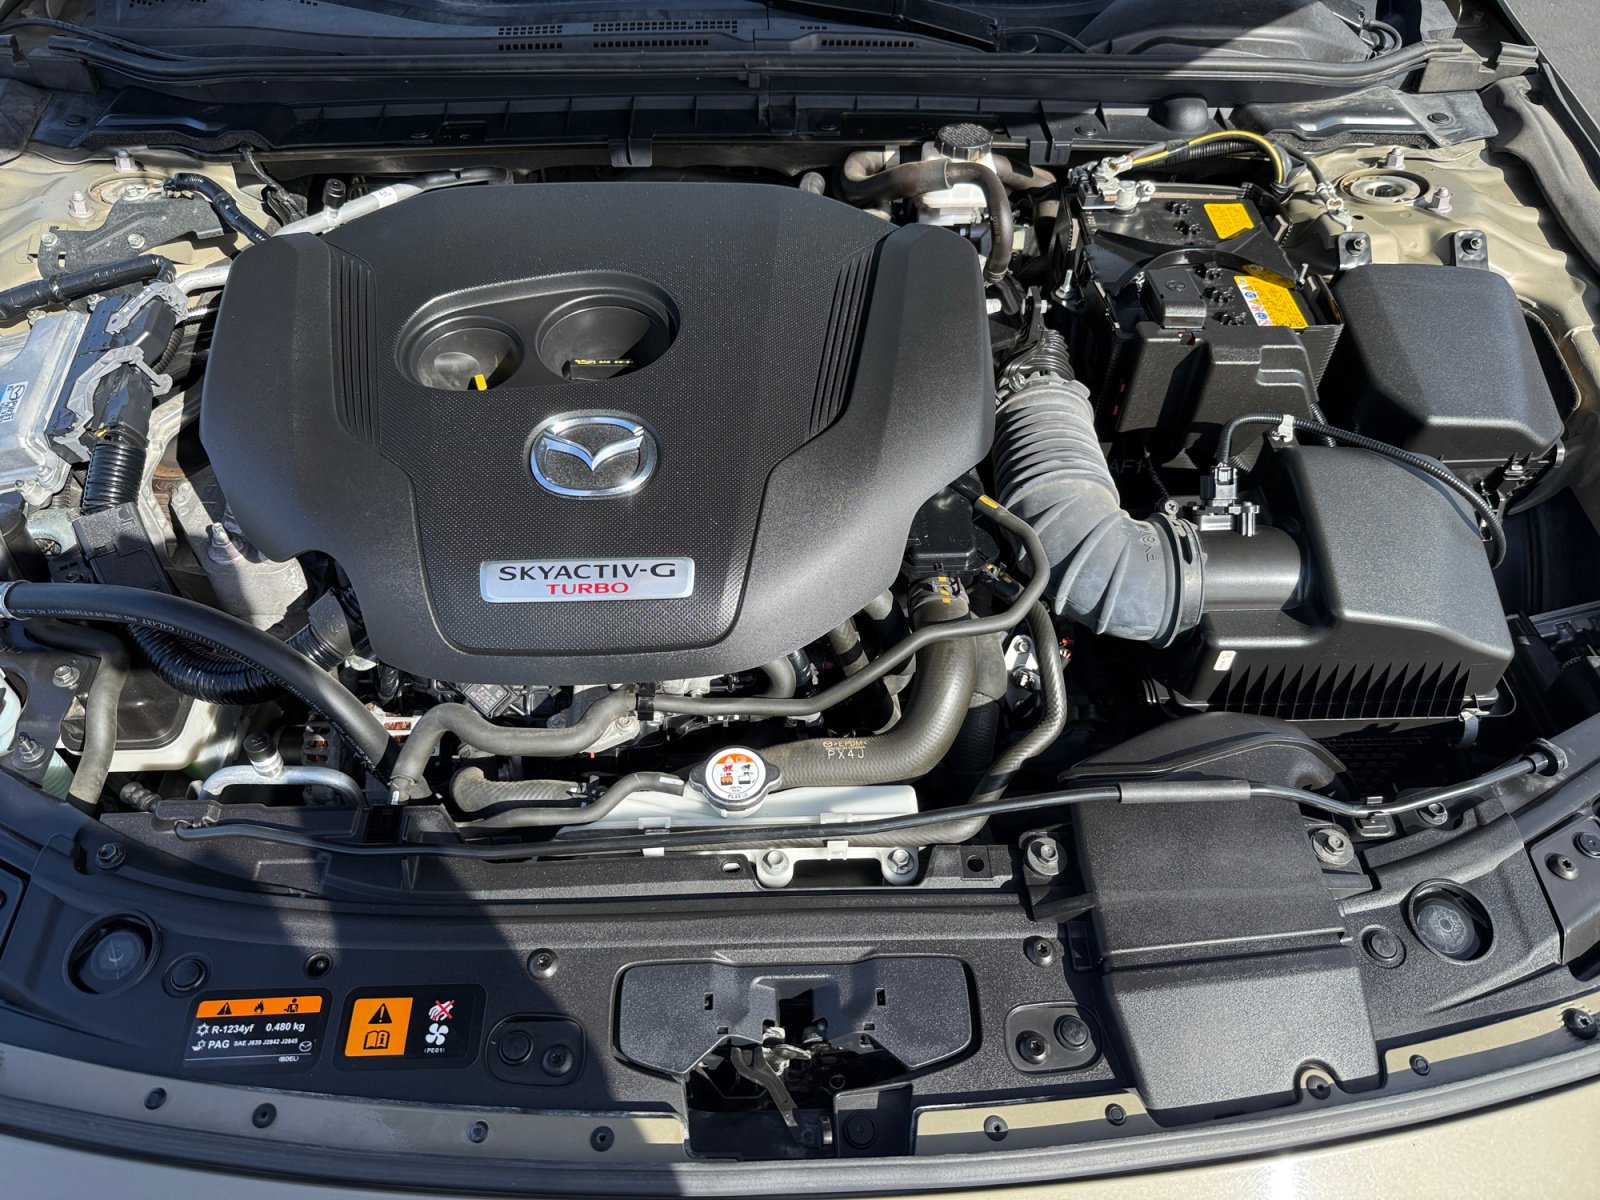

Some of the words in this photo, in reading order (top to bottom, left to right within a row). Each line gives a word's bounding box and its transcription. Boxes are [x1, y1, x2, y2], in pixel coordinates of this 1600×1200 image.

[499, 563, 676, 581] SKYACTIV-G
[546, 582, 629, 595] TURBO
[828, 749, 864, 759] PX4J
[211, 1023, 255, 1034] R-1234yf
[265, 1022, 291, 1031] 0.480
[293, 1022, 305, 1032] kg
[208, 1040, 230, 1049] PAG
